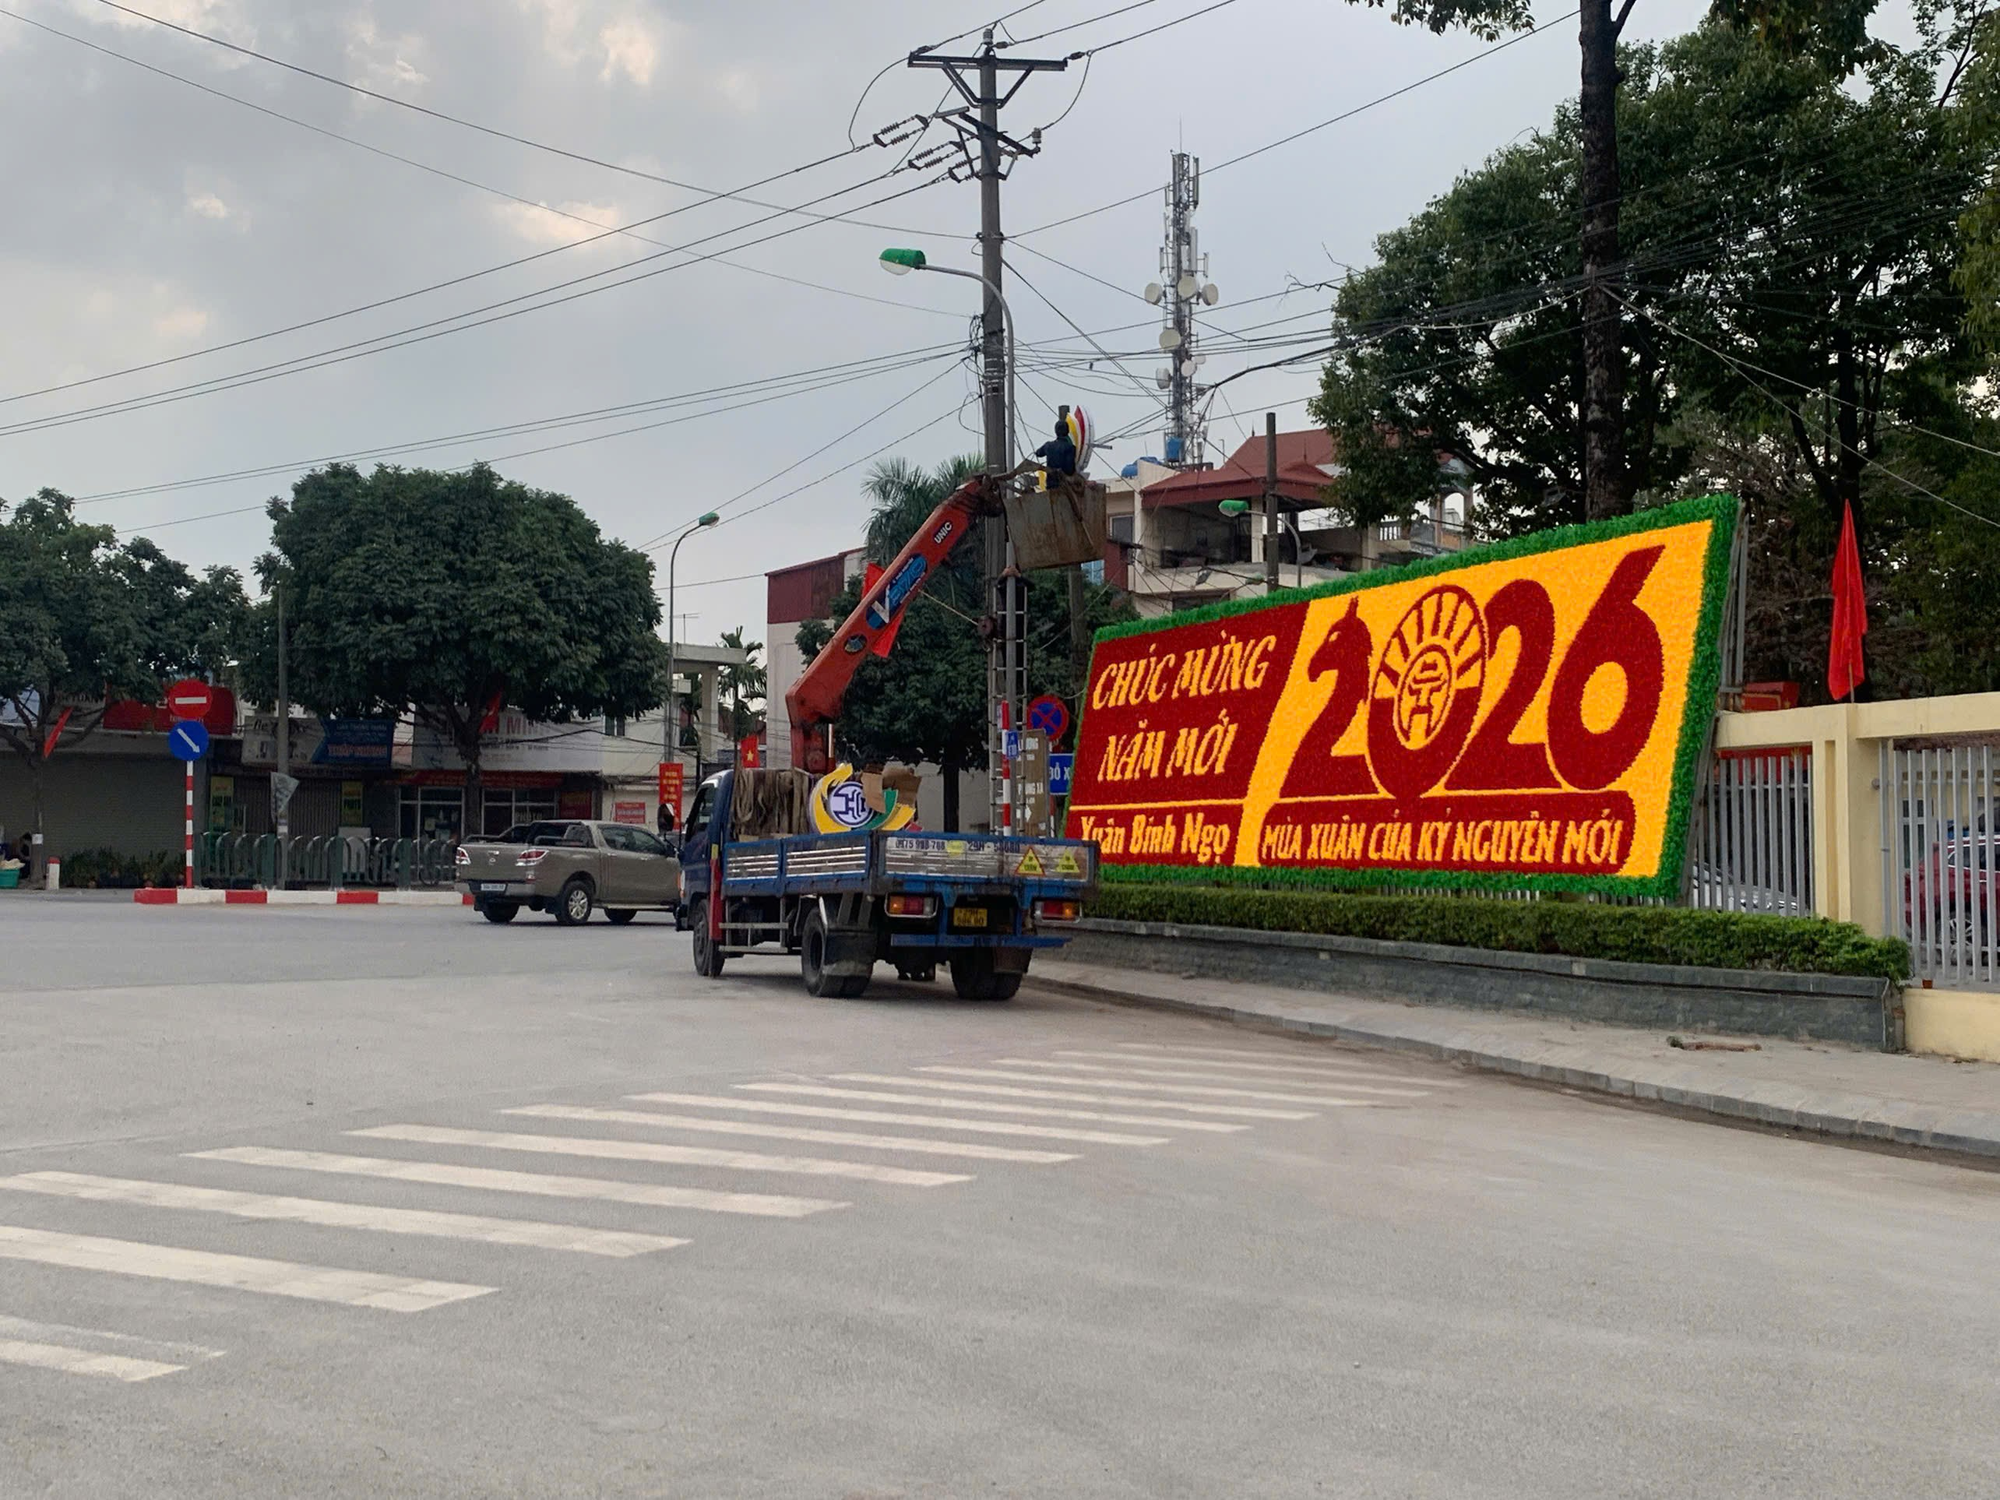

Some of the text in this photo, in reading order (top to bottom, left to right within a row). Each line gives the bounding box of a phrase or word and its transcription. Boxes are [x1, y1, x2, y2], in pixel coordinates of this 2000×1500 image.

[933, 521, 953, 544] UNIC
[1092, 629, 1277, 710] CHÚC MỪNG
[1278, 544, 1666, 800] 2026
[1097, 708, 1239, 782] NĂM MỚI
[1081, 812, 1231, 864] Xuân Bính Ngọ
[1261, 807, 1624, 865] MÙA XUÂN CỦA KỶ NGUYÊN MỚI
